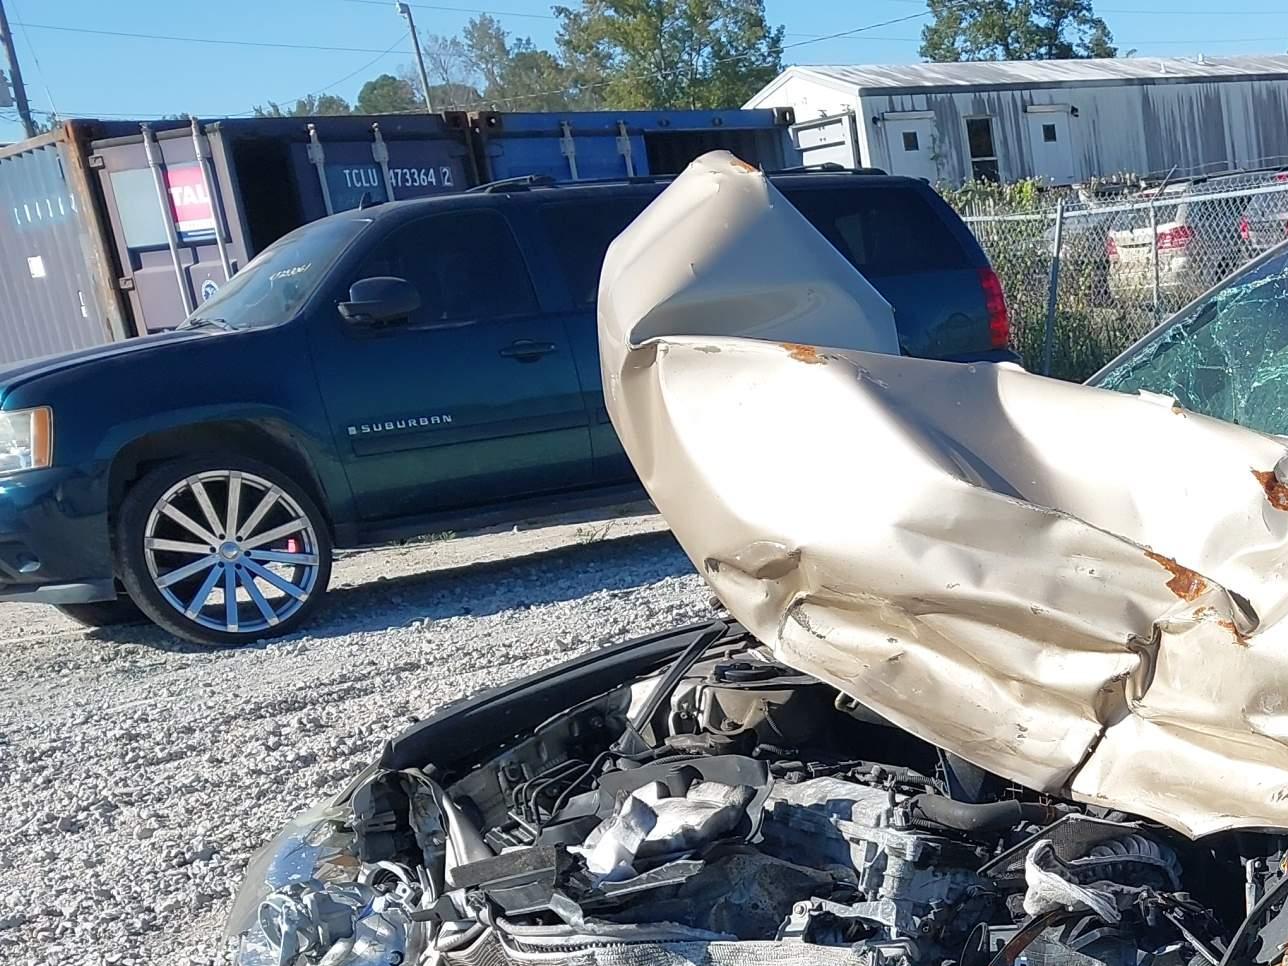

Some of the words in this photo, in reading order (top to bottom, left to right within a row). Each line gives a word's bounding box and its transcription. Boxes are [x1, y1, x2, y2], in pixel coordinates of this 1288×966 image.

[343, 168, 379, 188] TCLU
[441, 167, 453, 186] 2
[361, 415, 453, 434] SUBURBAN
